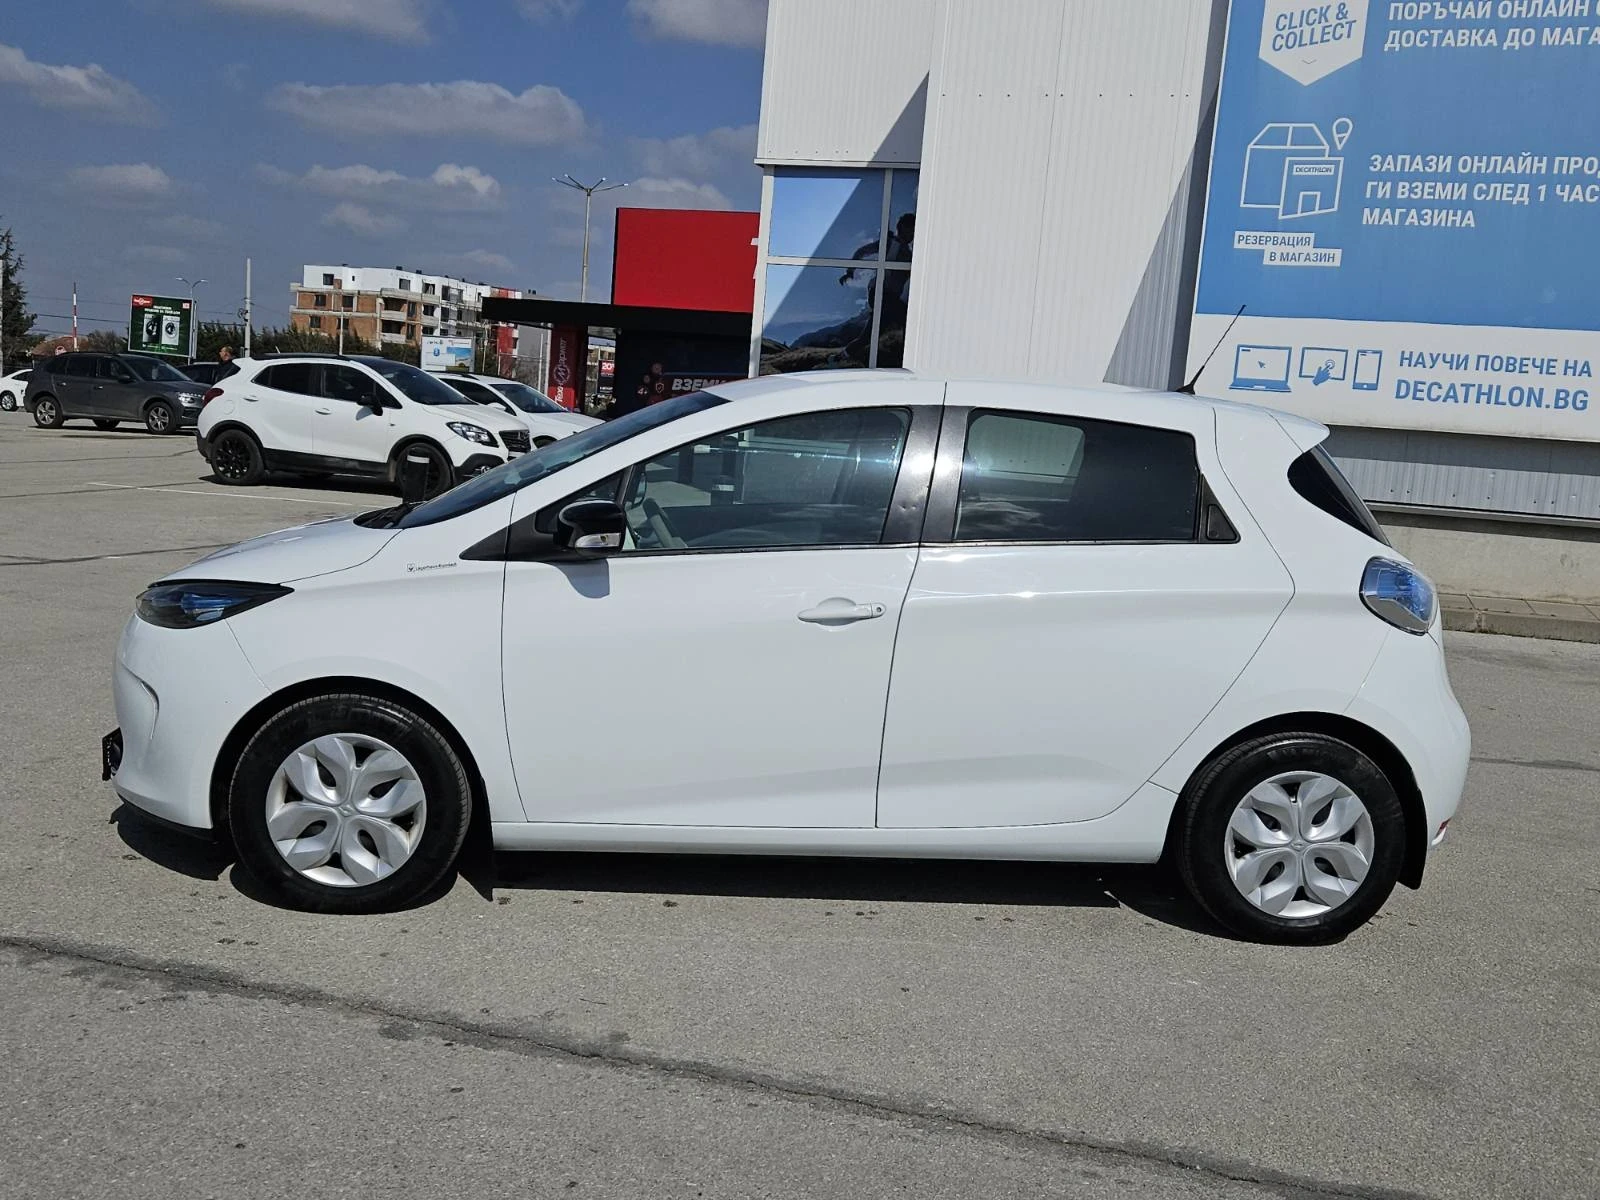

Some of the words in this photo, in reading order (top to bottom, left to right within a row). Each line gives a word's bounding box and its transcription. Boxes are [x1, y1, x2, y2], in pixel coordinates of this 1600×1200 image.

[1275, 4, 1331, 31] CLICK
[1336, 2, 1348, 20] &
[1388, 0, 1493, 20] ПОРЪЧАЙ
[1272, 19, 1357, 52] COLLECT
[1384, 28, 1498, 51] ДОСТАВКА
[1502, 27, 1536, 50] ДО
[1368, 154, 1453, 173] ЗАПАЗИ
[1457, 151, 1548, 175] ОНЛАЙН
[1552, 156, 1600, 179] ПРО
[1365, 181, 1392, 199] ГИ
[1396, 181, 1468, 200] ВЗЕМИ
[1472, 183, 1530, 205] СЛЕД
[1537, 184, 1547, 202] 1
[1555, 184, 1600, 203] ЧАС
[1362, 207, 1476, 228] МАГАЗИНА
[1237, 234, 1311, 249] РЕЗЕРВАЦИЯ
[1269, 251, 1277, 262] В
[1279, 252, 1336, 263] МАГАЗИН
[1400, 350, 1470, 371] НАУЧИ
[1475, 354, 1558, 375] ПОВЕЧЕ
[1563, 359, 1593, 377] НА
[1394, 379, 1589, 411] DECATHLON.BG
